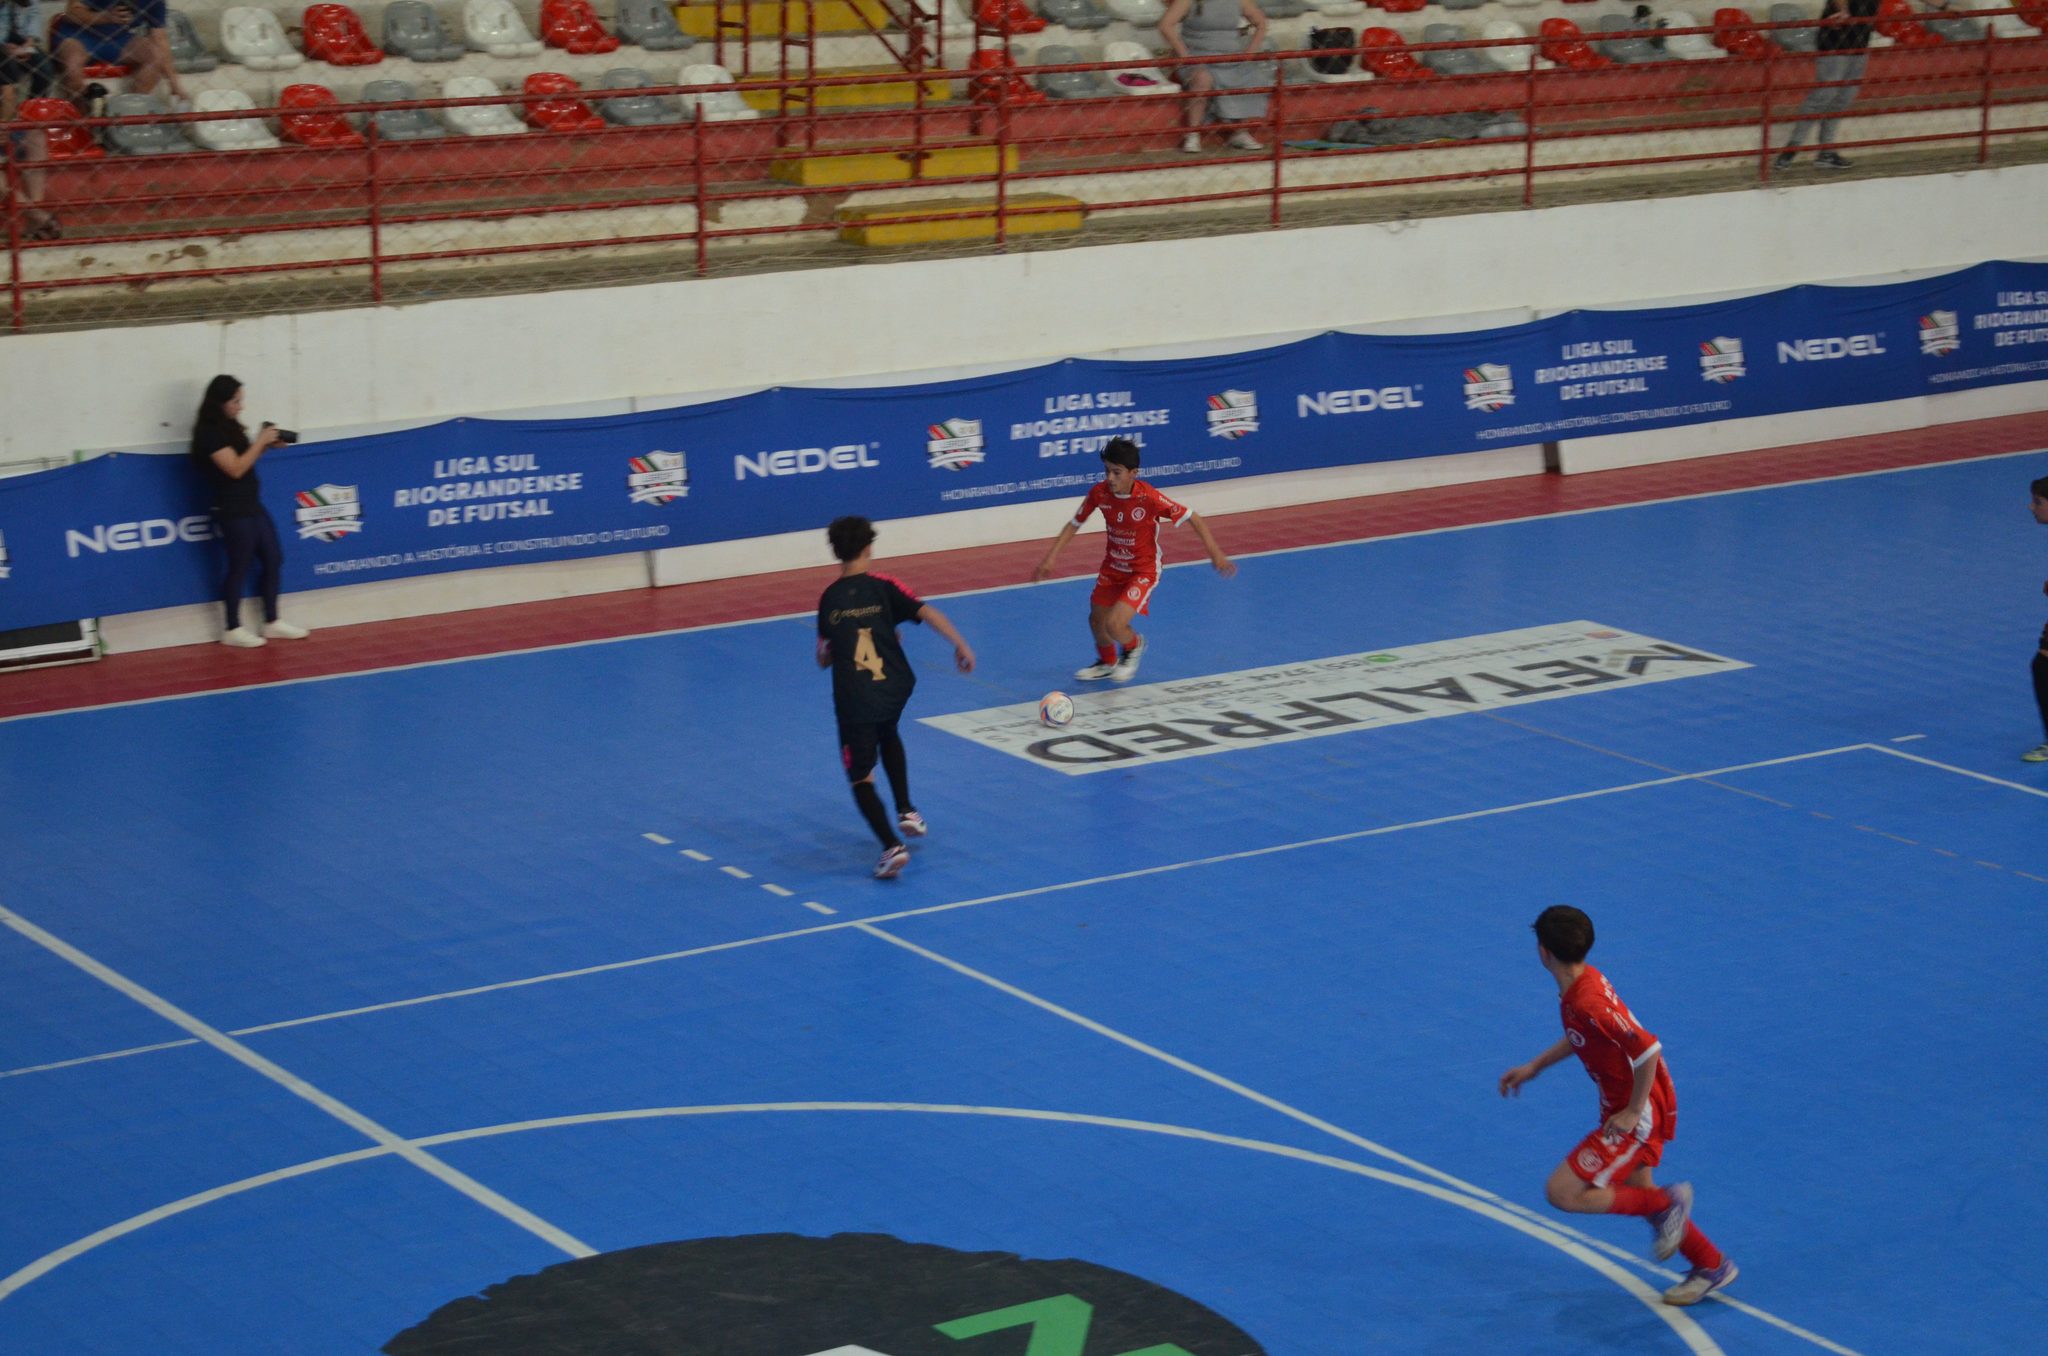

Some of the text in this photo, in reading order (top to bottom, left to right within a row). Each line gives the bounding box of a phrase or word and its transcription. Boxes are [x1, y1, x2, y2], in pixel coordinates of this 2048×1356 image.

[1561, 339, 1637, 360] LIGA SUL
[1776, 334, 1886, 364] NEDEL
[1534, 355, 1668, 384] RIOGRANDENSE
[1044, 391, 1136, 414] LIGA SUL
[1297, 387, 1423, 418] NEDEL
[1559, 377, 1649, 401] DE FUTSAL
[1009, 408, 1171, 440] RIOGRANDENSE
[734, 445, 880, 480] NEDEL
[1038, 439, 1068, 458] DE
[434, 453, 540, 479] LIGA SUL
[394, 472, 583, 507] RIOGRANDENSE
[428, 498, 553, 527] DE FUTSAL
[1117, 512, 1124, 523] 9
[65, 514, 222, 558] NEDE
[314, 524, 670, 574] HONRANDO A HISTÓRIA E CONSTRUINDO O FUTURO
[854, 627, 887, 680] 4
[1026, 644, 1728, 763] METALFRED
